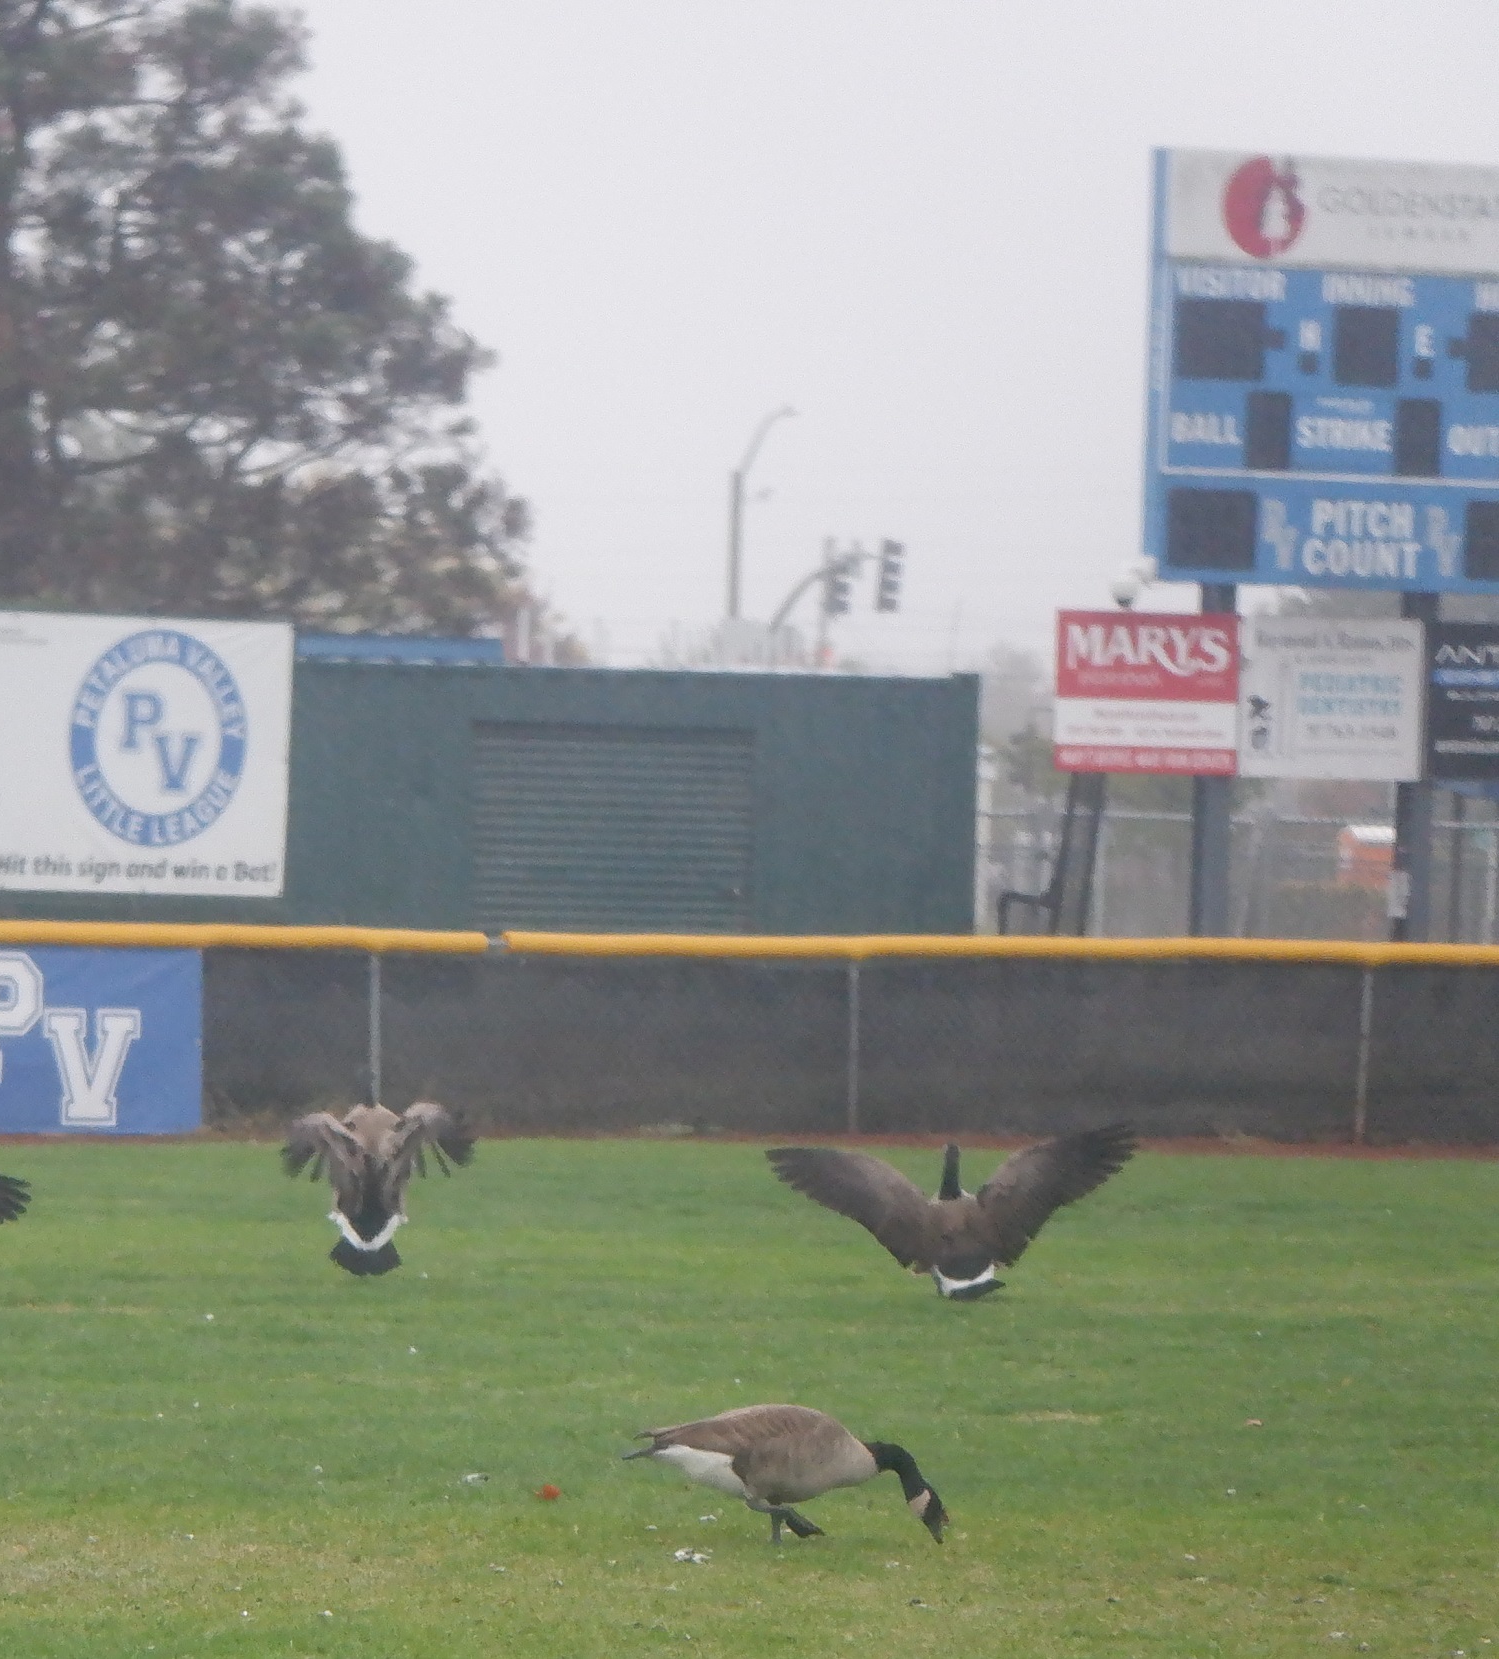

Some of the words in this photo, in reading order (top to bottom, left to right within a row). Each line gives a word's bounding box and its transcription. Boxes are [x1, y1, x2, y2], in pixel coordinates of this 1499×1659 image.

[1177, 269, 1287, 300] VISITOR
[1322, 275, 1416, 307] INNING
[1171, 411, 1242, 446] BALL
[1296, 416, 1394, 452] STRIKE
[1311, 499, 1415, 538] PITCH
[1301, 538, 1422, 578] COUNT
[70, 632, 182, 729] PETALUMA
[184, 638, 247, 738] VALLEY
[73, 764, 145, 842] LITTLE
[152, 772, 238, 844] LEAGUE
[32, 855, 72, 877] this
[77, 856, 121, 885] sign
[125, 857, 168, 879] and
[172, 858, 210, 880] win
[215, 864, 229, 881] a
